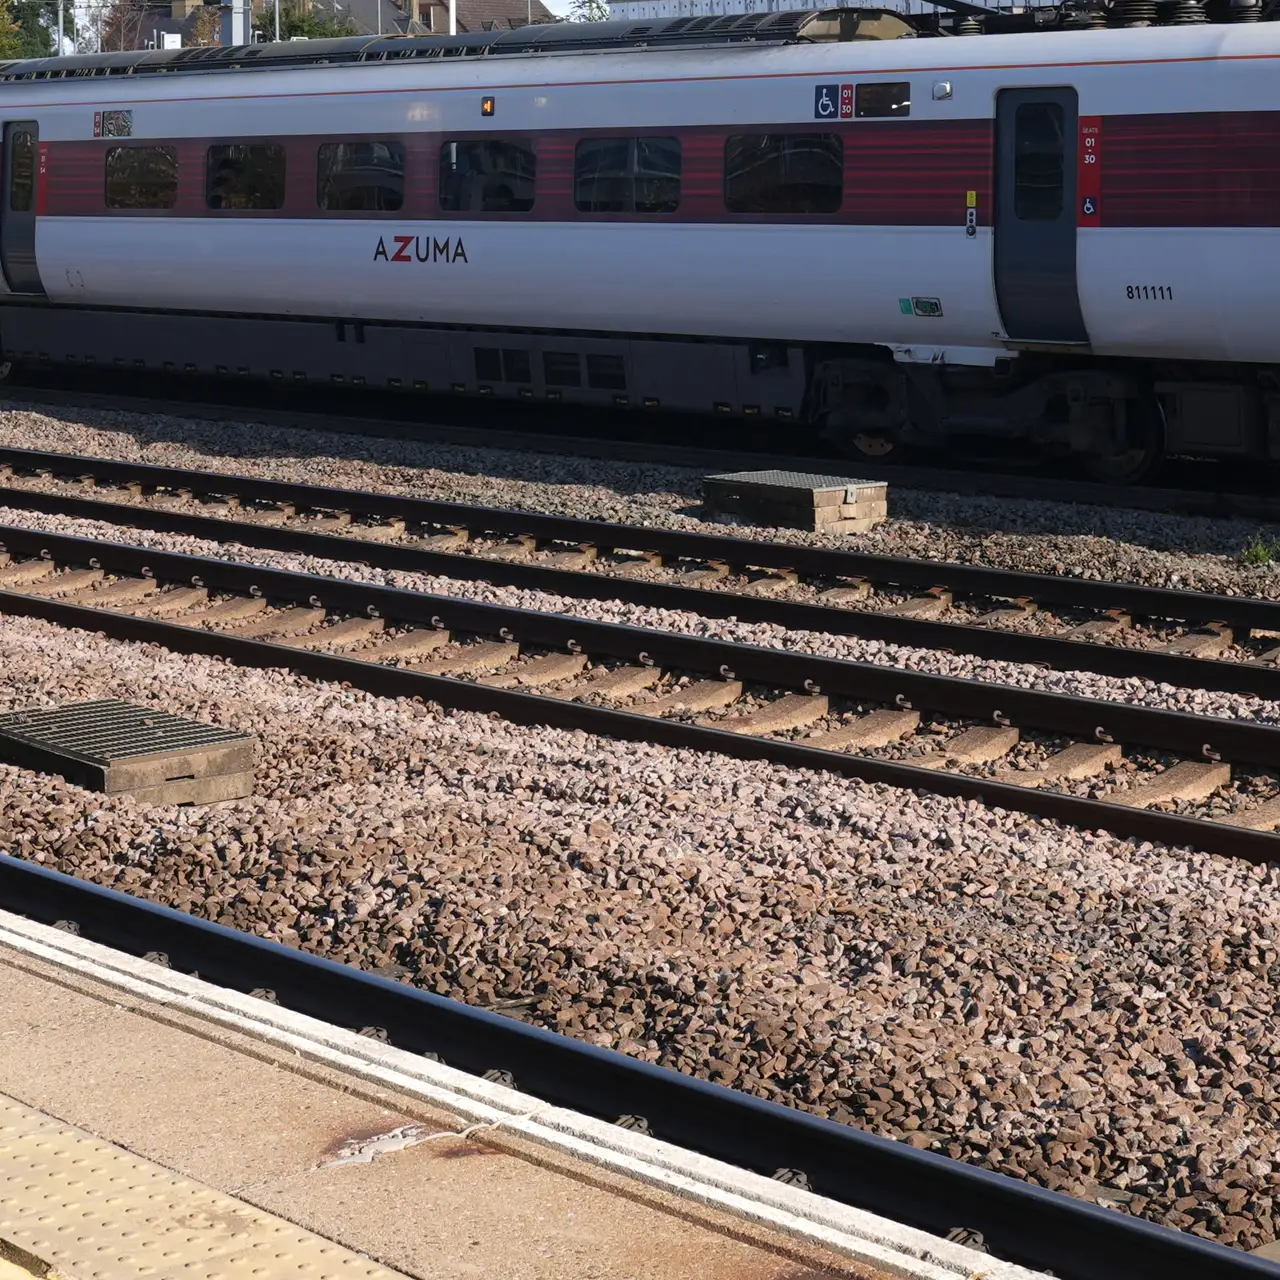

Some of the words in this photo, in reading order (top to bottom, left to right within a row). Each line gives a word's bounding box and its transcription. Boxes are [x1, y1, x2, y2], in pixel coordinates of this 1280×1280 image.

[843, 90, 851, 98] 01
[842, 105, 852, 114] 30
[1085, 138, 1095, 147] 01
[1084, 155, 1096, 164] 30
[373, 235, 468, 263] AZUMA
[1126, 285, 1173, 300] 811111
